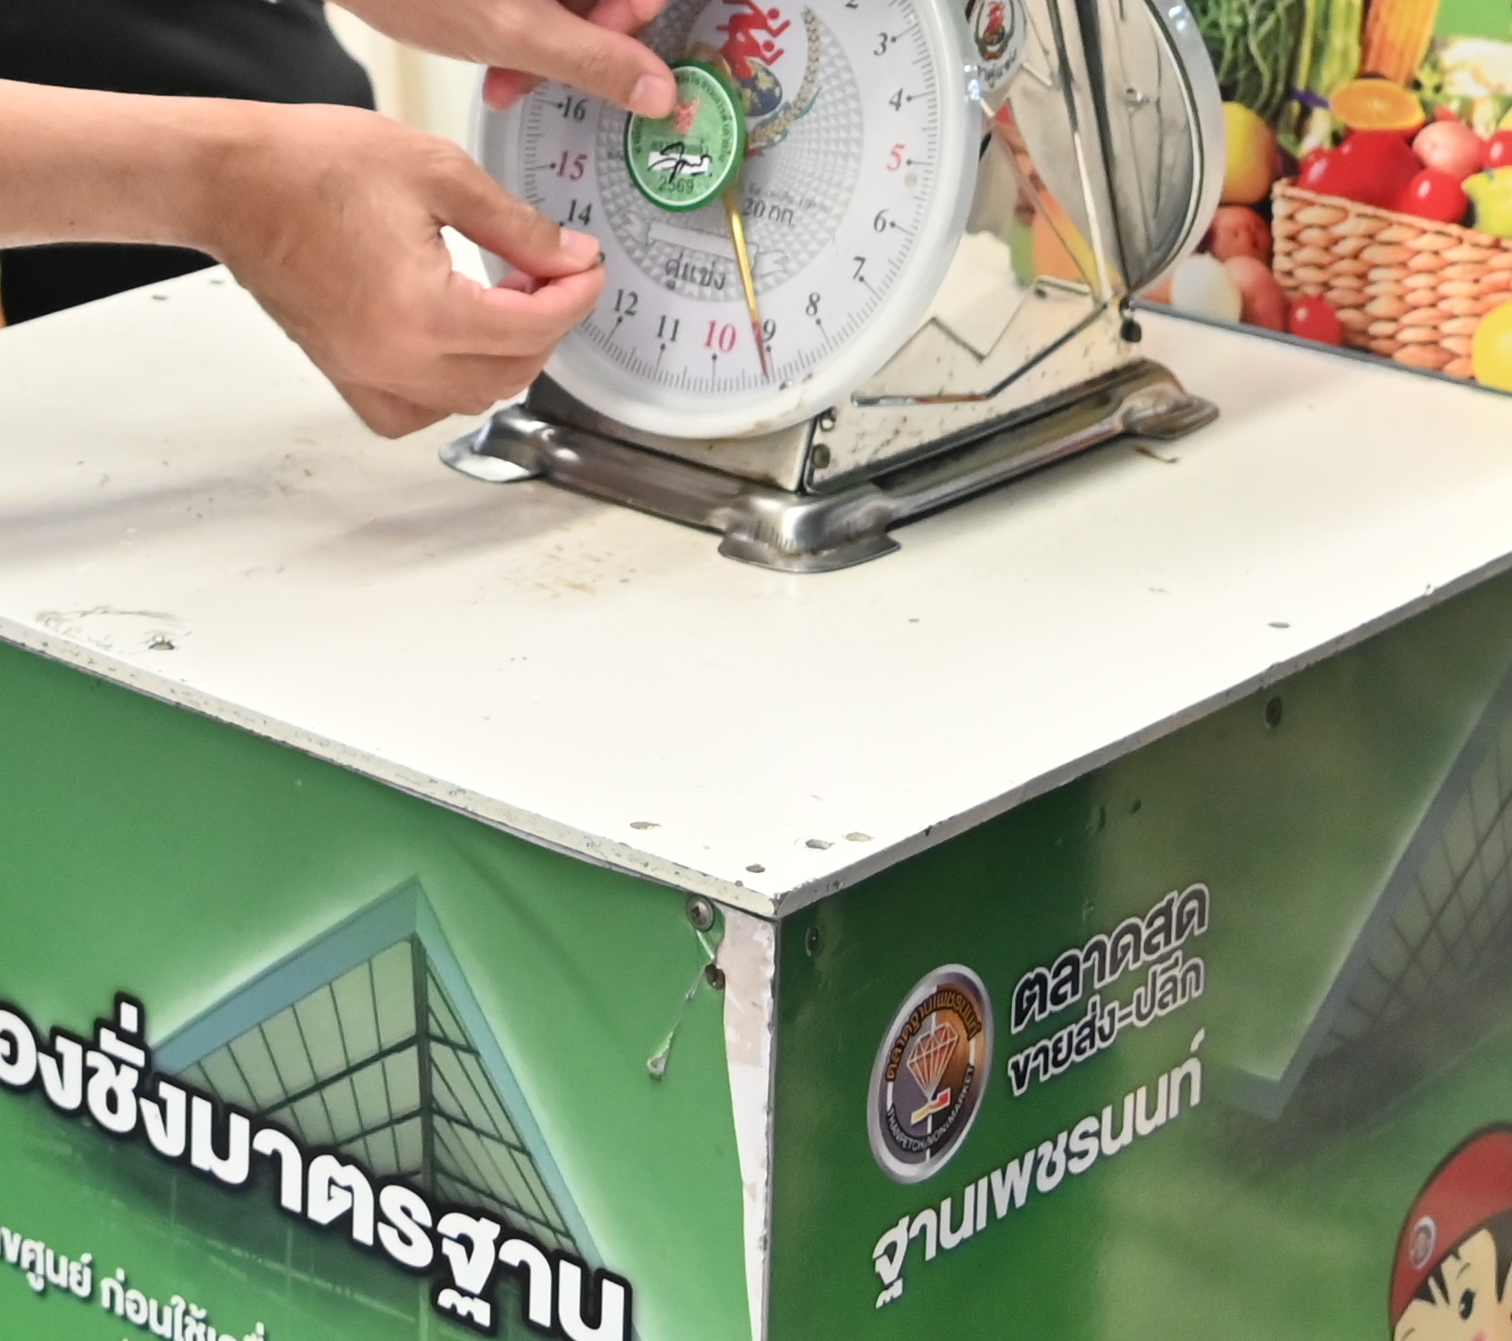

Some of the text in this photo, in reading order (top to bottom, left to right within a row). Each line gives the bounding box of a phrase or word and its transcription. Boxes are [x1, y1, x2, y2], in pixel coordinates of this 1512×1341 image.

[872, 31, 889, 57] 3
[562, 94, 589, 123] 16
[888, 87, 904, 111] 4
[556, 149, 588, 181] 15
[886, 143, 906, 172] 5
[567, 199, 593, 226] 14
[873, 208, 890, 233] 6
[851, 255, 867, 281] 7
[613, 288, 639, 317] 12
[805, 291, 821, 317] 8
[656, 314, 680, 343] 11
[705, 319, 737, 352] 10
[762, 319, 777, 343] 9
[1011, 883, 1211, 1035] ตลาดสด
[1007, 951, 1206, 1097] ขายส่ง-ปลีก
[873, 1027, 1206, 1309] ฐานเพชรนนท์
